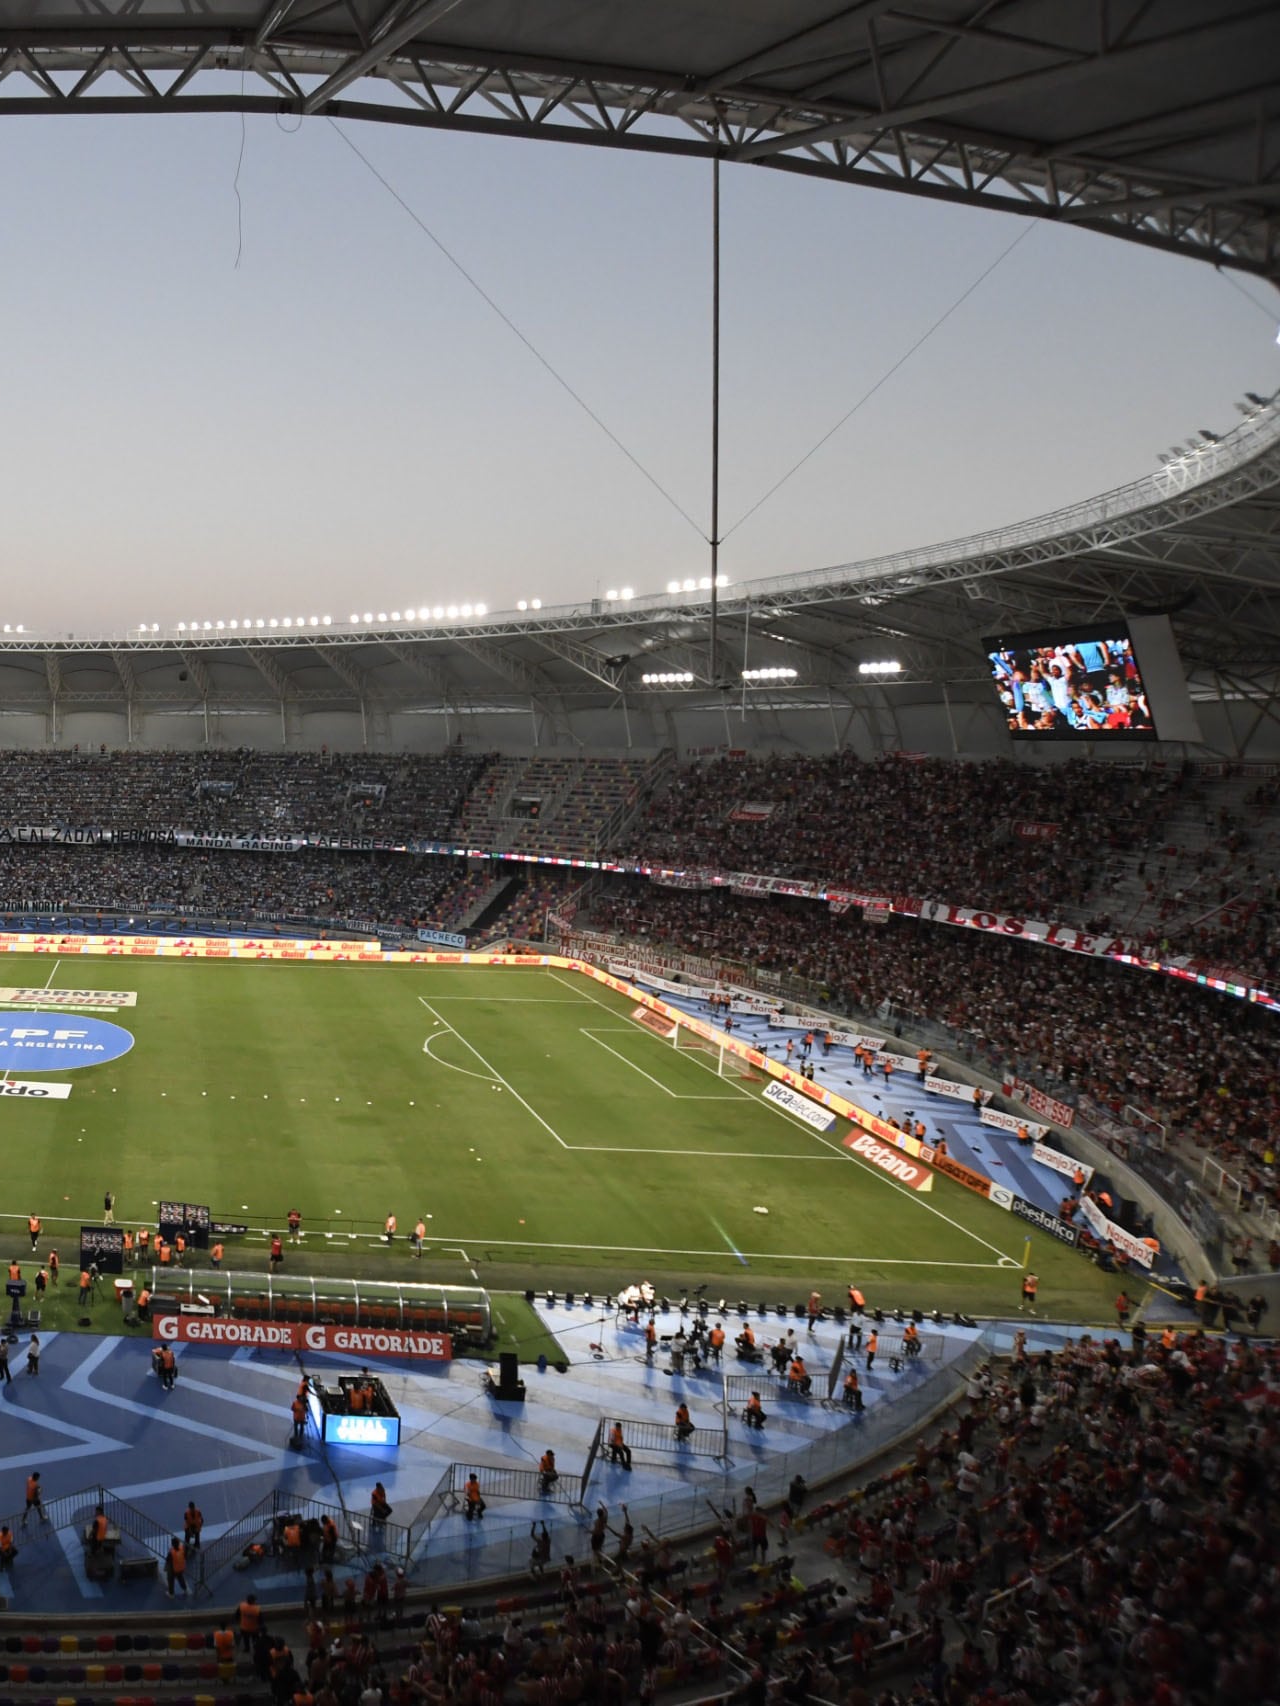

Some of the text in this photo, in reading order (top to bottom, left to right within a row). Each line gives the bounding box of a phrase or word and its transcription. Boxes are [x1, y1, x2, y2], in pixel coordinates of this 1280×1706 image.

[17, 828, 95, 844] CALZADA
[110, 829, 175, 843] HERMOSA
[186, 838, 293, 851] MANDA RACING
[32, 901, 64, 913] NORTE
[946, 905, 1026, 935] LOS
[420, 930, 464, 944] PACHECO
[15, 989, 130, 999] TORNEO
[13, 1041, 106, 1051] ARGENTINA
[766, 1083, 830, 1129] sicaelec.com
[849, 1133, 919, 1182] Betano
[186, 1322, 292, 1345] GATORADE
[334, 1332, 444, 1356] GATORADE
